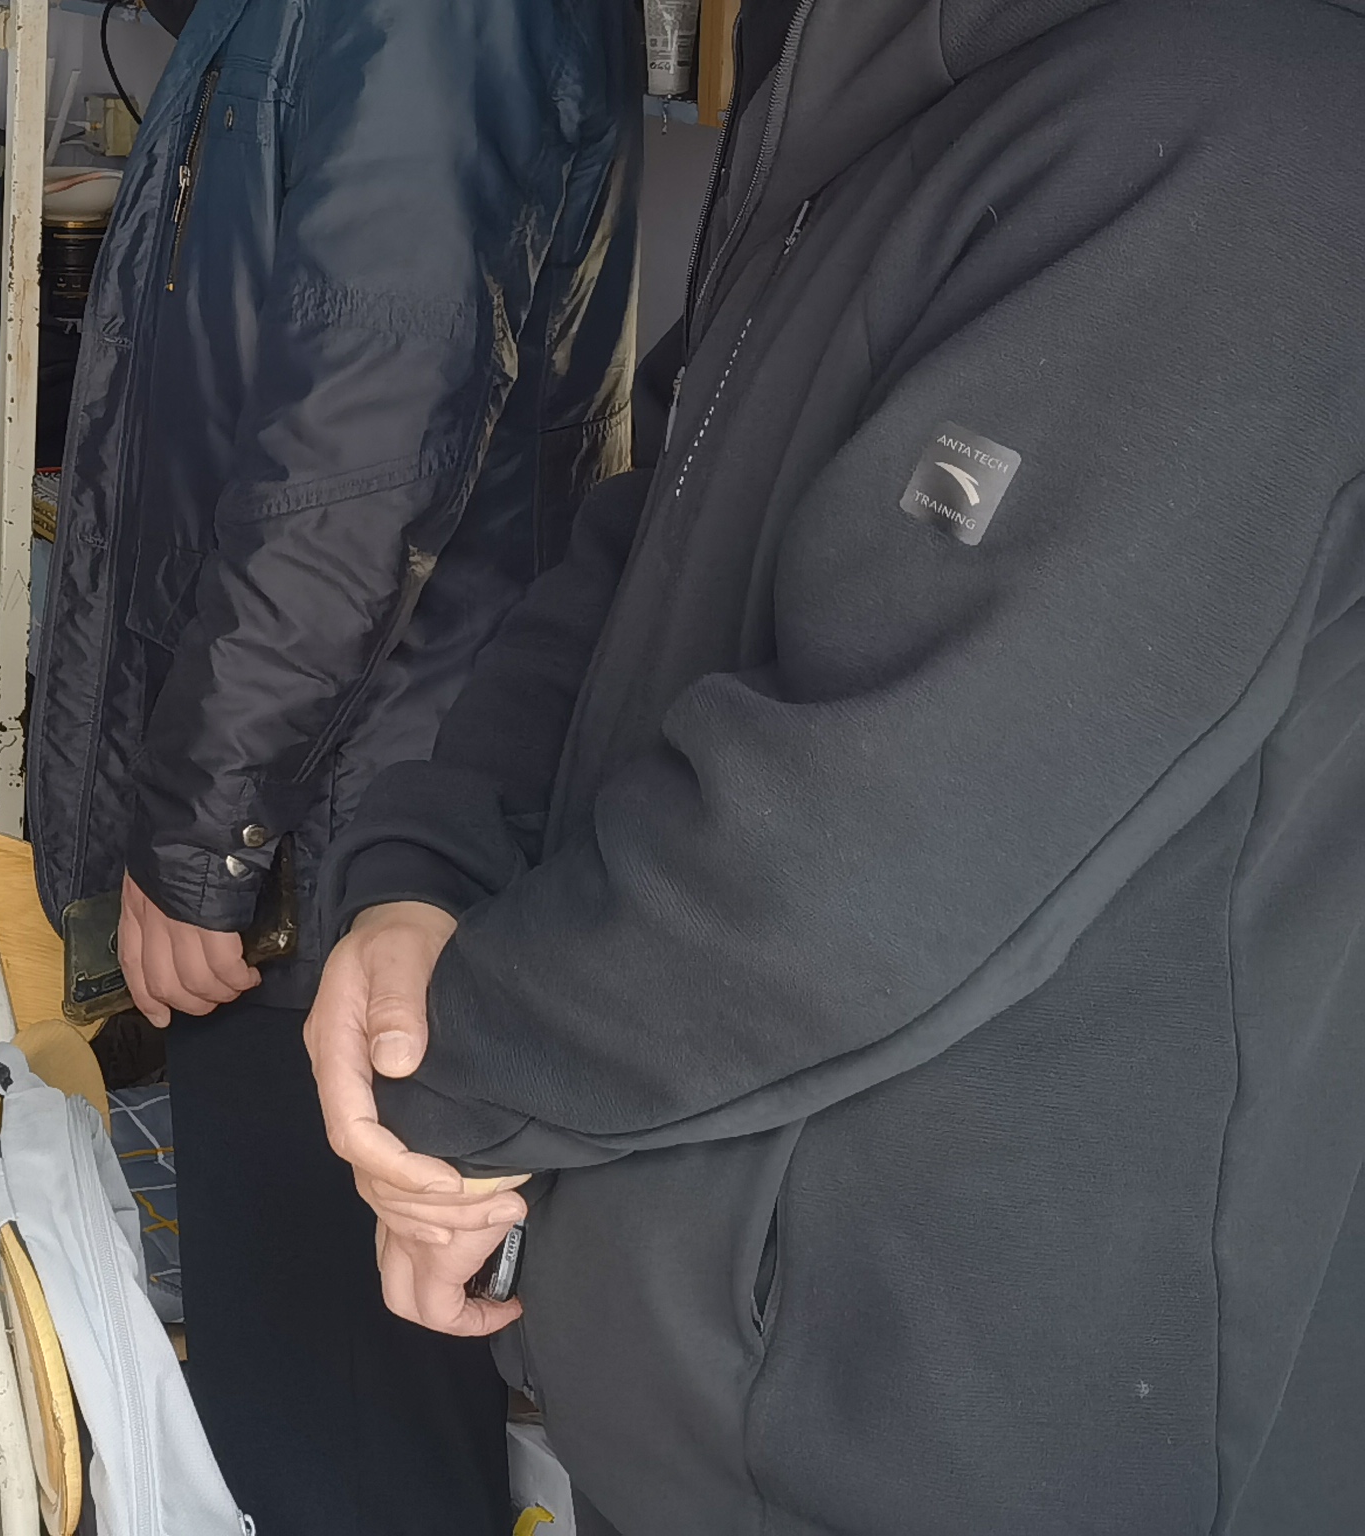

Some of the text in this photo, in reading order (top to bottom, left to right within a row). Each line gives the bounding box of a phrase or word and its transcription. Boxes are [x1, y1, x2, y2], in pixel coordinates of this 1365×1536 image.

[936, 434, 1009, 474] ANTA TECH
[913, 490, 977, 530] TRAINING
